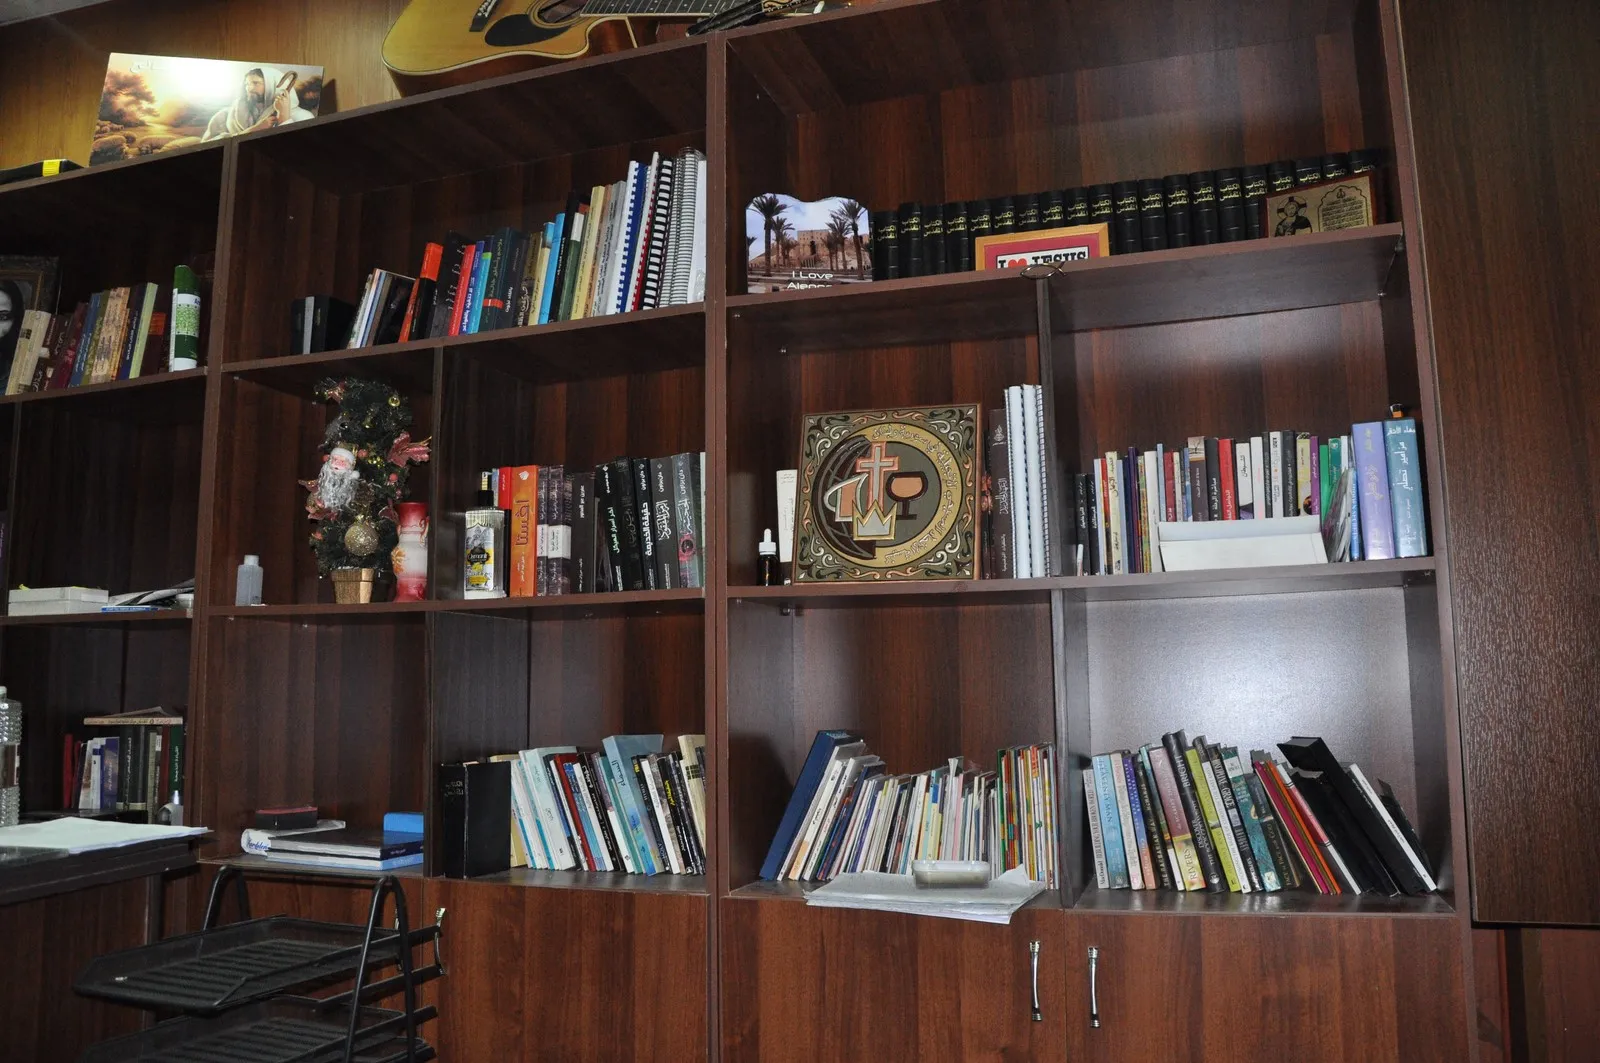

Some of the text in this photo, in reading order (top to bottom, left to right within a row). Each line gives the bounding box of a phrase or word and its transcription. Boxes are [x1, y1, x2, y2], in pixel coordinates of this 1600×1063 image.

[1245, 180, 1266, 189] الكتاب
[1272, 176, 1294, 184] الكتاب
[1194, 186, 1213, 195] الكتاب
[1220, 183, 1240, 192] الكتاب
[1142, 193, 1162, 202] الكتاب
[1168, 189, 1188, 198] الكتاب
[1092, 199, 1112, 208] الكتاب
[1117, 196, 1137, 205] الكتاب
[1043, 205, 1062, 214] الكتاب
[1068, 202, 1087, 211] الكتاب
[995, 211, 1014, 219] الكتاب
[1019, 208, 1038, 217] الكتاب
[901, 216, 920, 225] الكتاب
[947, 216, 967, 224] الكتاب
[971, 214, 990, 222] الكتاب
[924, 219, 943, 228] الكتاب
[878, 225, 896, 233] الكتاب
[998, 259, 1006, 269] I
[800, 271, 833, 280] Love
[1393, 440, 1411, 466] مزامير
[611, 758, 627, 788] السماء
[1175, 754, 1191, 788] BRIGHT
[1221, 786, 1235, 809] GRACE
[1104, 802, 1114, 823] MAN
[1191, 817, 1204, 850] DISCOVER
[1202, 833, 1211, 854] BOOK
[1189, 848, 1200, 881] RIVERS
